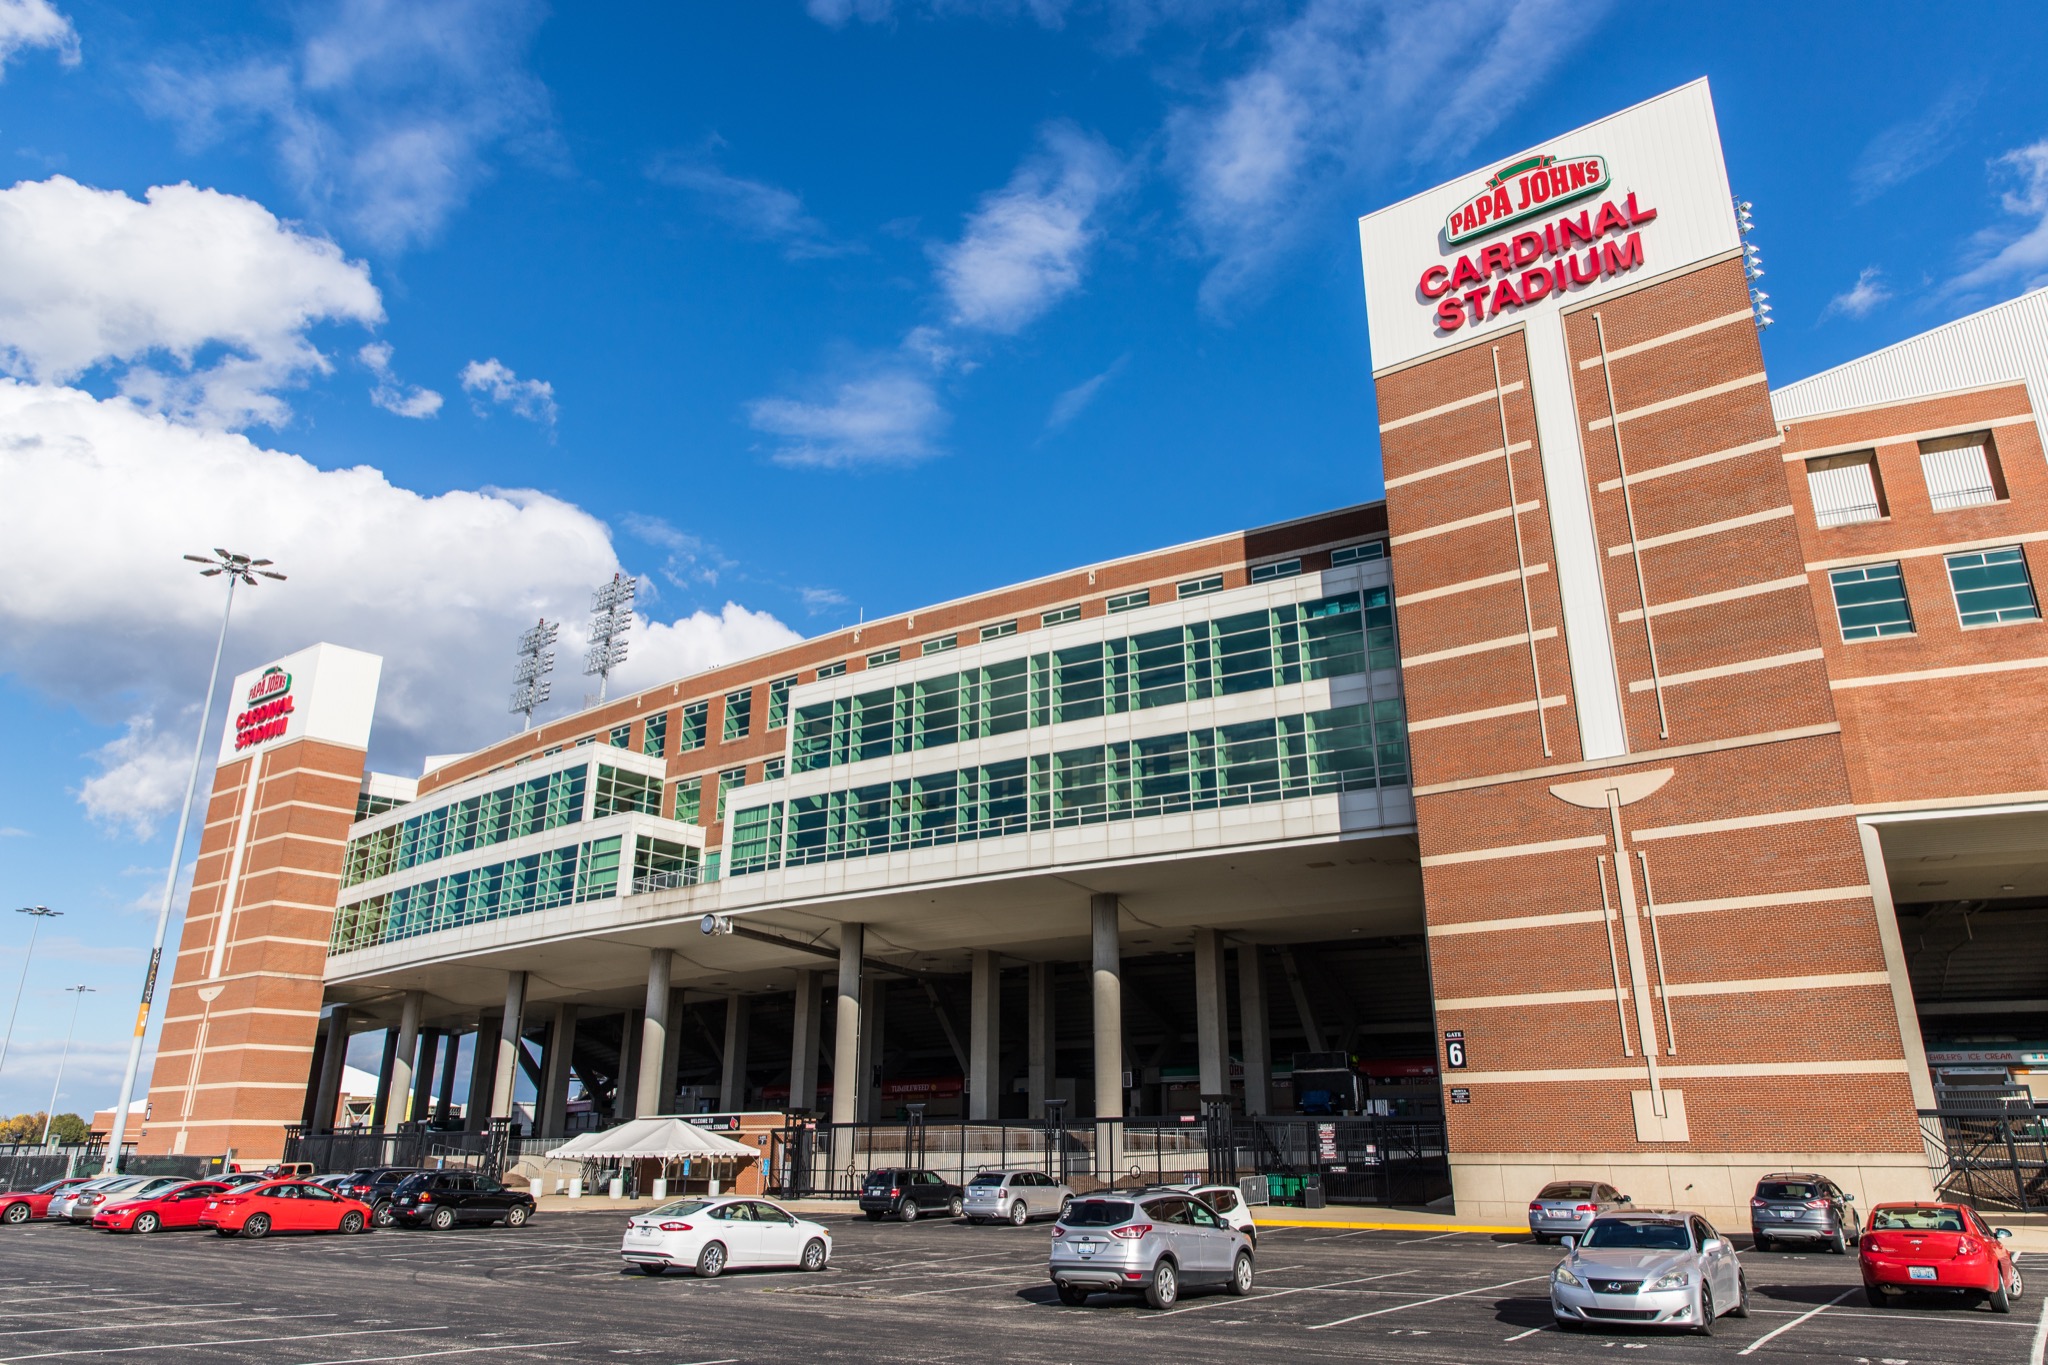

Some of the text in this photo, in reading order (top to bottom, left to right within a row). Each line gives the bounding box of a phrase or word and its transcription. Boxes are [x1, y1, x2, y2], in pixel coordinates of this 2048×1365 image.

[1450, 160, 1600, 236] PAPA JOHN'S
[1420, 191, 1658, 298] CARDINAL
[1437, 232, 1644, 331] STADIUM
[248, 679, 266, 700] PAPA
[236, 695, 295, 732] CARDINAL
[235, 717, 289, 752] STADIUM
[1449, 1043, 1463, 1066] 6
[1984, 1052, 2013, 1060] CREAM
[891, 1084, 930, 1093] TUMBLEWEED
